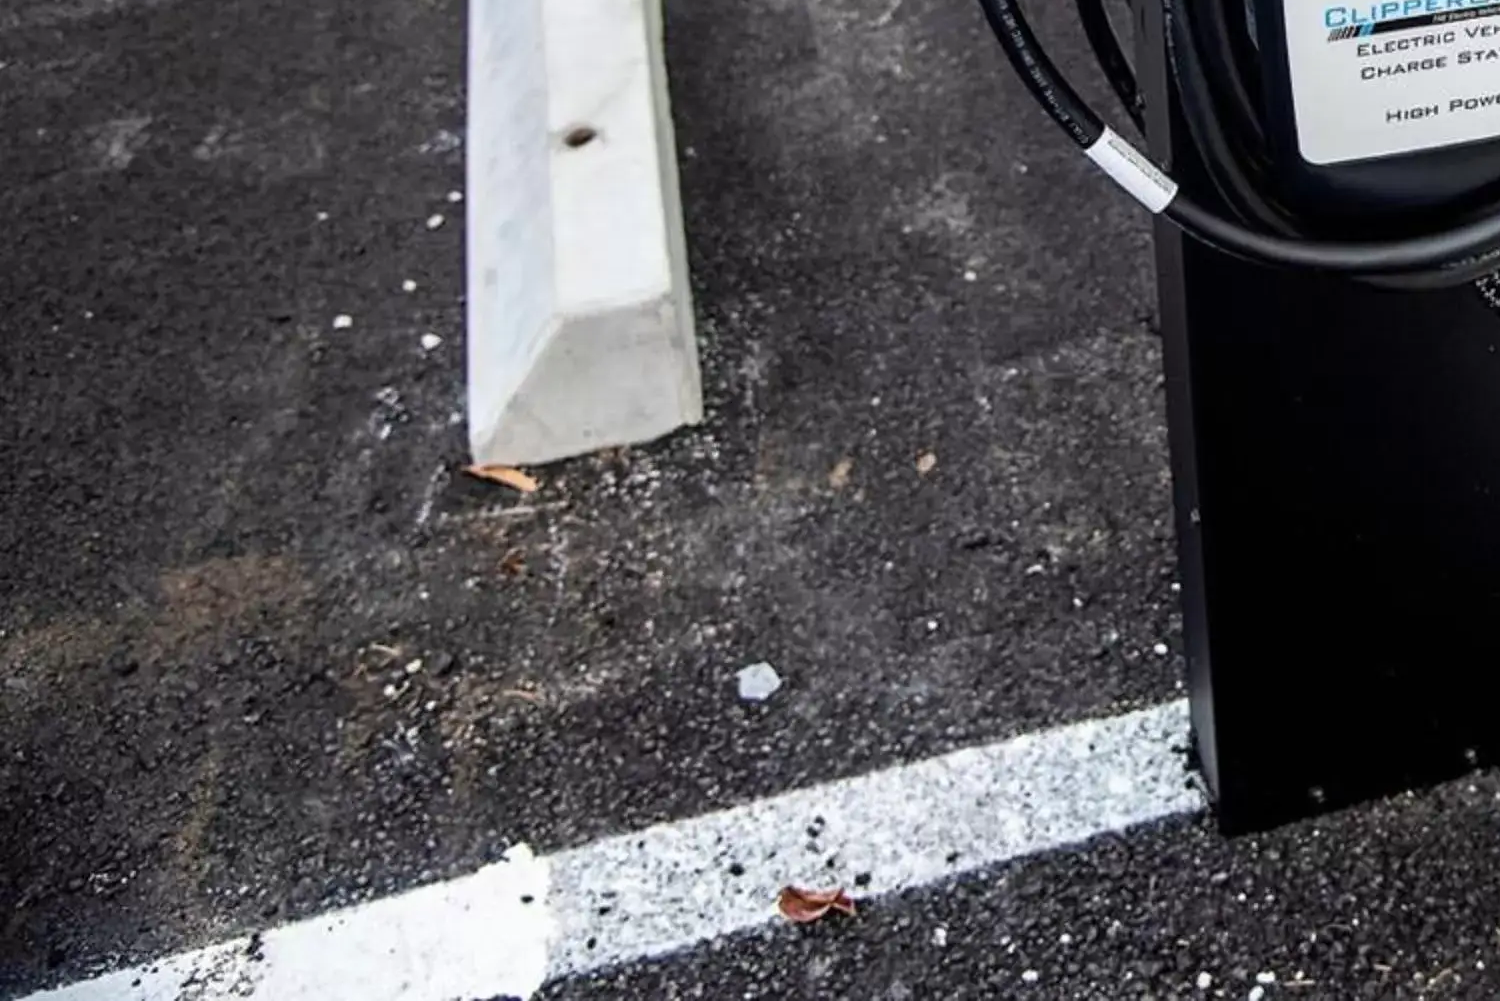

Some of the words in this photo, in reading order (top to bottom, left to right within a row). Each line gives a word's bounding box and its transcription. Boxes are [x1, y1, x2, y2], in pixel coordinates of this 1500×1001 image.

[1357, 31, 1456, 58] ELECTRIC
[1360, 56, 1447, 80] CHARGE
[1386, 105, 1439, 123] HIGH
